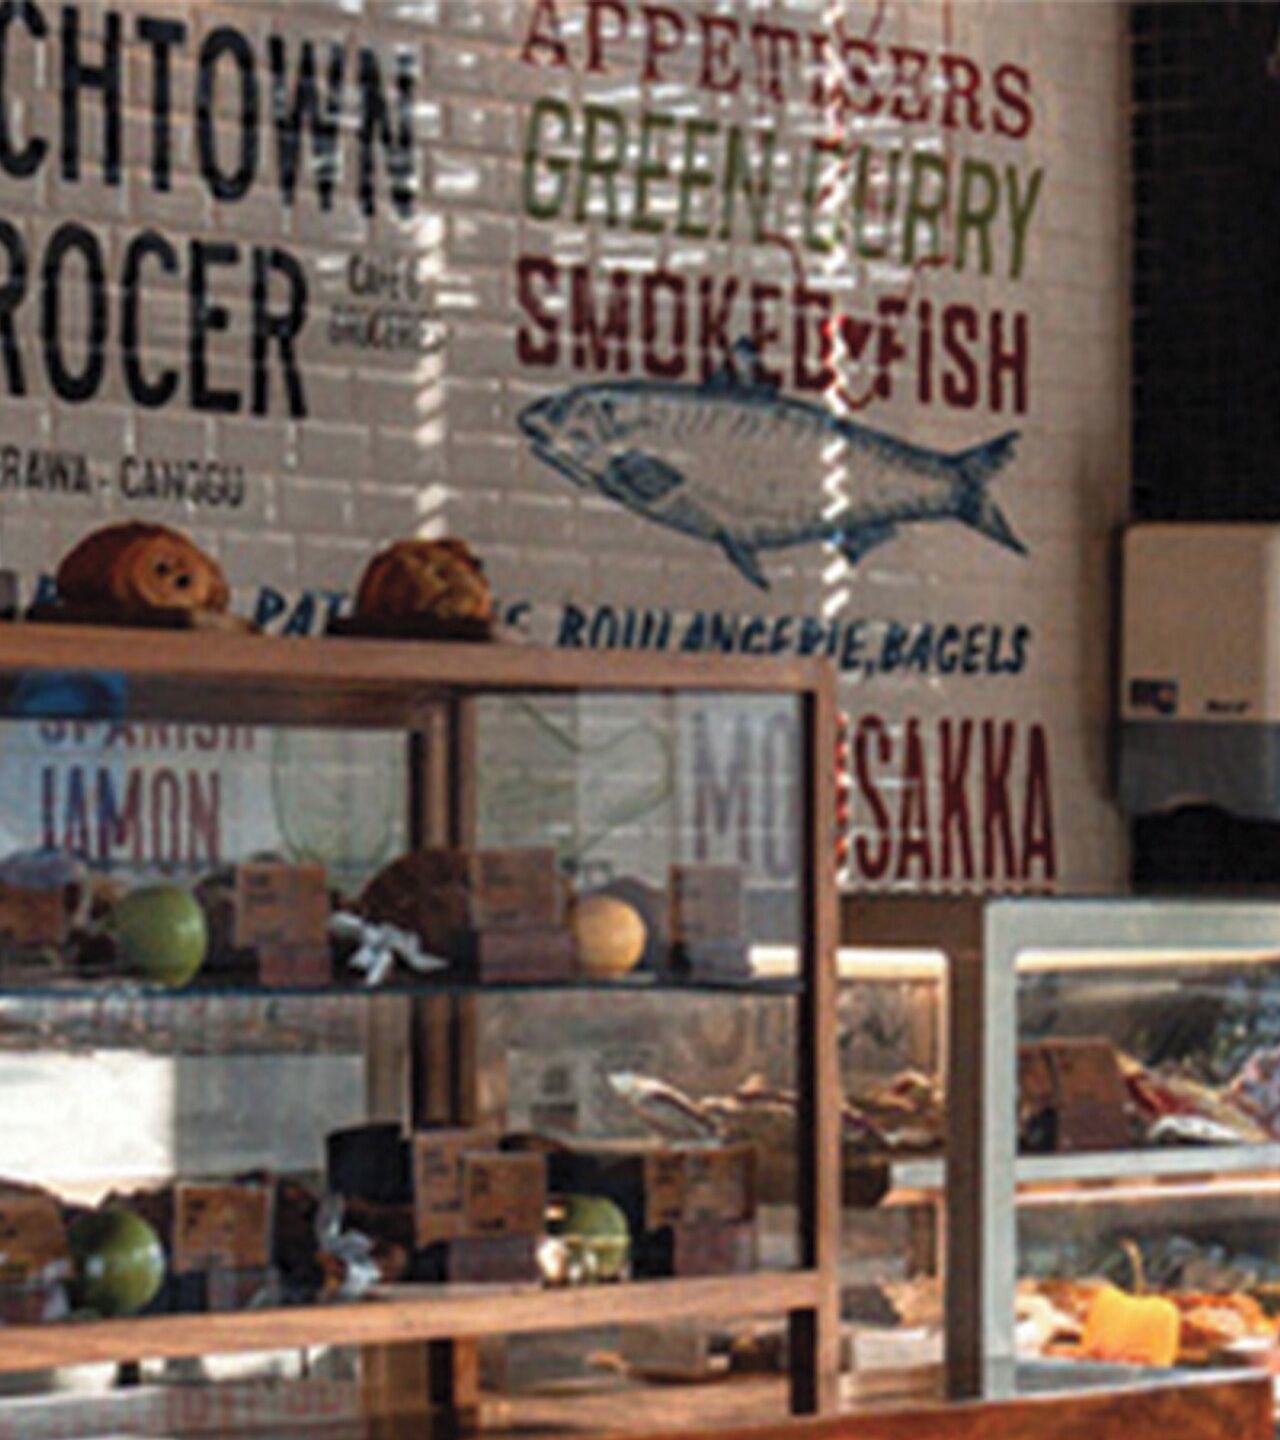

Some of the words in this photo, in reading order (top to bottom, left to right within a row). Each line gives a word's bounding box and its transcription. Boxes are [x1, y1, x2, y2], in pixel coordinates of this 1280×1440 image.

[520, 0, 1036, 138] APPETISERS
[522, 96, 778, 245] GREEN
[802, 140, 1045, 280] CURRY
[514, 255, 840, 394] SMOKED
[866, 296, 1030, 414] FISH
[120, 455, 244, 508] CANGGU
[692, 710, 1055, 882] MOSAKKA
